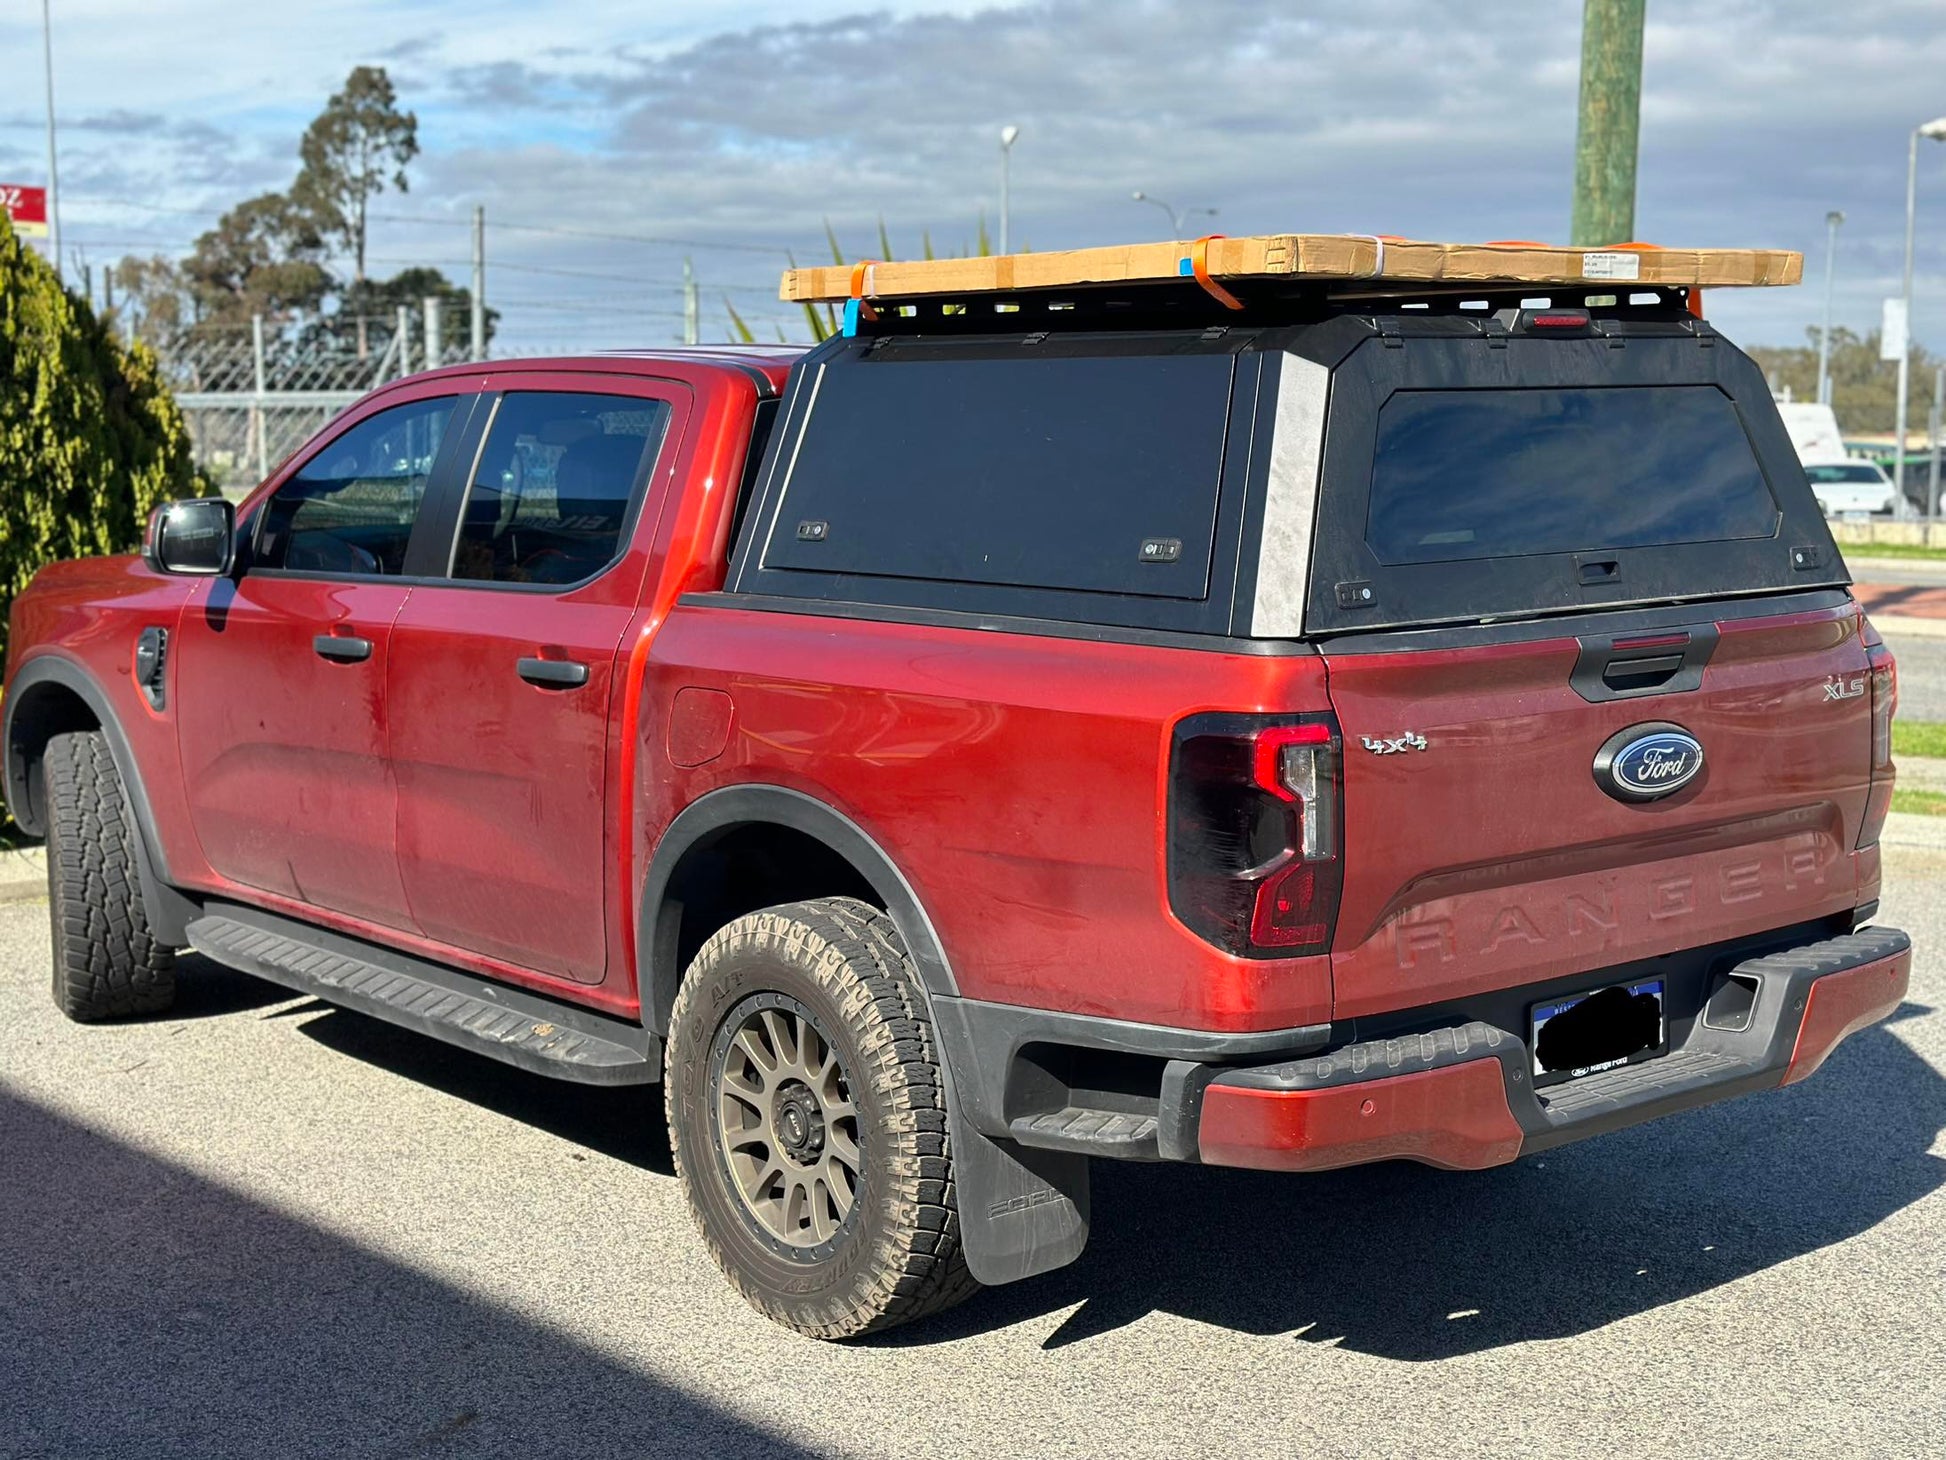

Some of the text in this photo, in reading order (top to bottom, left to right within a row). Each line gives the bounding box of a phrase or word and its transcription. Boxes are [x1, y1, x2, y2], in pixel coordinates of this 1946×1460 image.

[1822, 678, 1865, 702] XLS
[1638, 746, 1686, 781] Ford
[1396, 842, 1826, 969] RANGER
